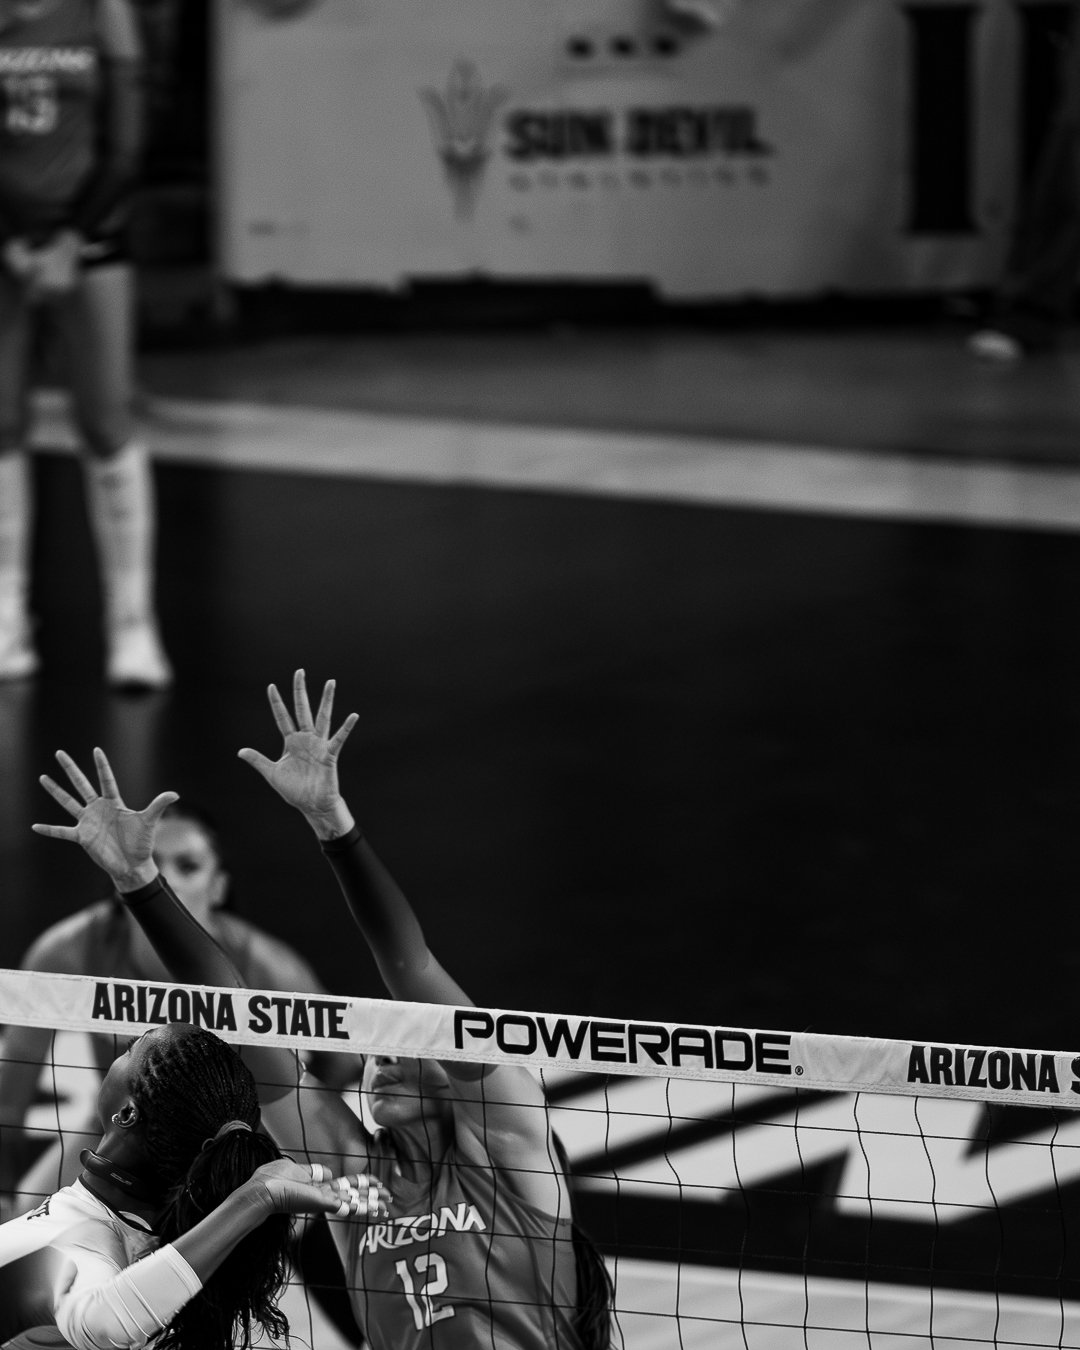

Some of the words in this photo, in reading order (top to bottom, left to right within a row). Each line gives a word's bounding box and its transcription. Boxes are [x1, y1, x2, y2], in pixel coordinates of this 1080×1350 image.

[91, 982, 237, 1032] ARIZONA
[247, 995, 351, 1040] STATE
[907, 1045, 1060, 1093] ARIZONA
[359, 1203, 486, 1256] ARIZONA
[395, 1253, 455, 1330] 12
